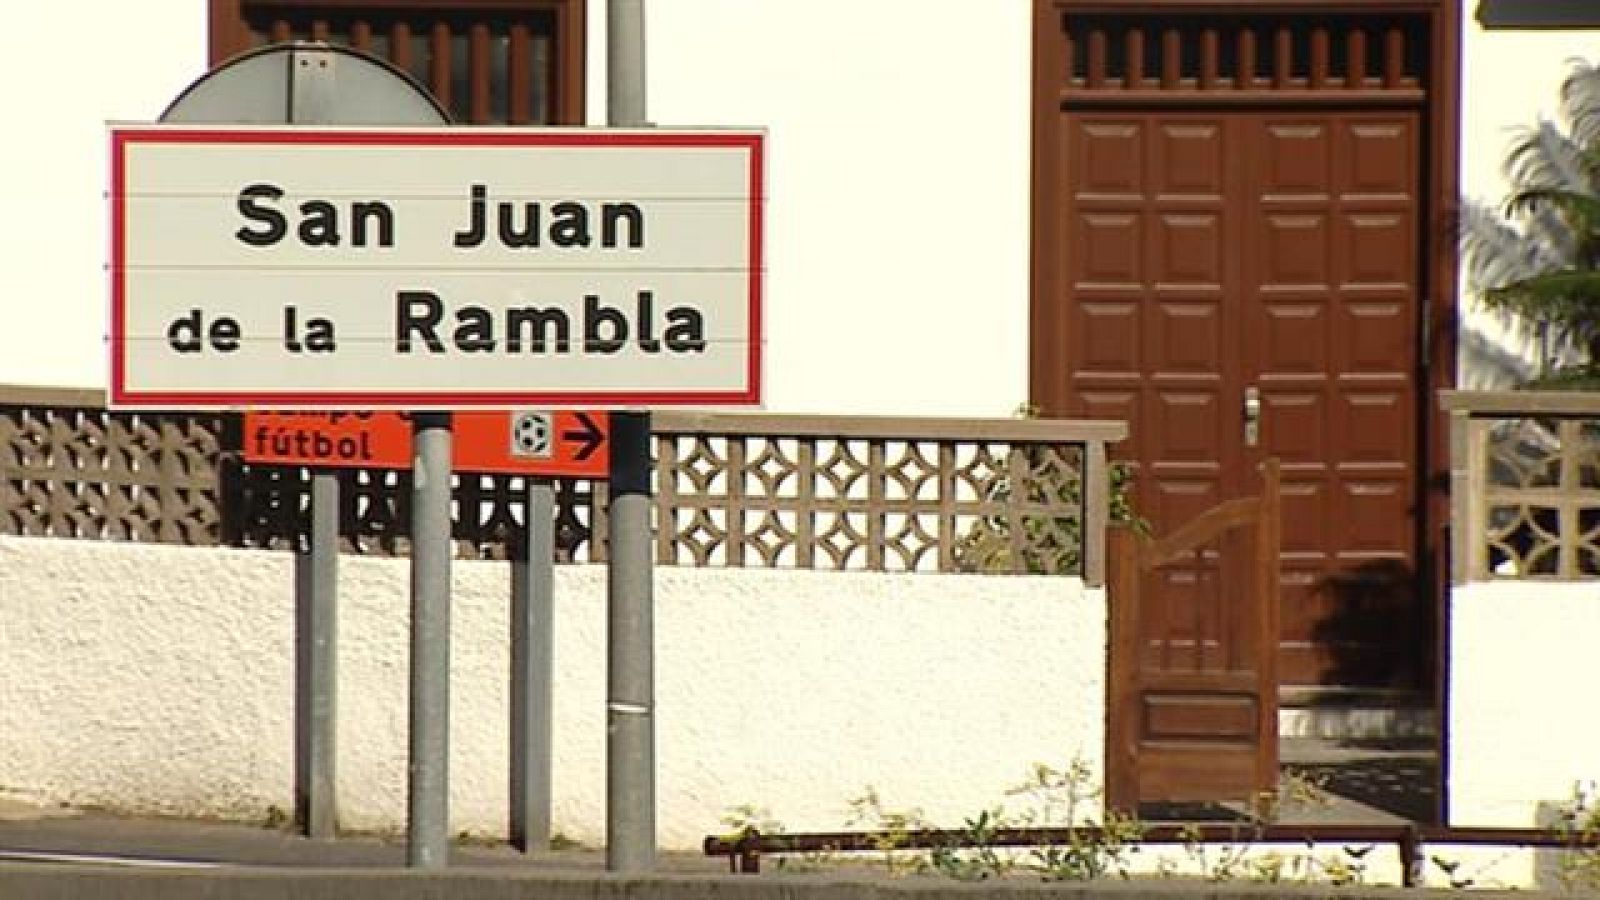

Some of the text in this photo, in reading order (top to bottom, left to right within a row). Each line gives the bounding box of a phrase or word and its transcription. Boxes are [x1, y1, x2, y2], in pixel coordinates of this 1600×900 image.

[236, 184, 644, 249] San Juan
[167, 291, 706, 355] de la Rambla
[254, 425, 372, 460] fútbol
